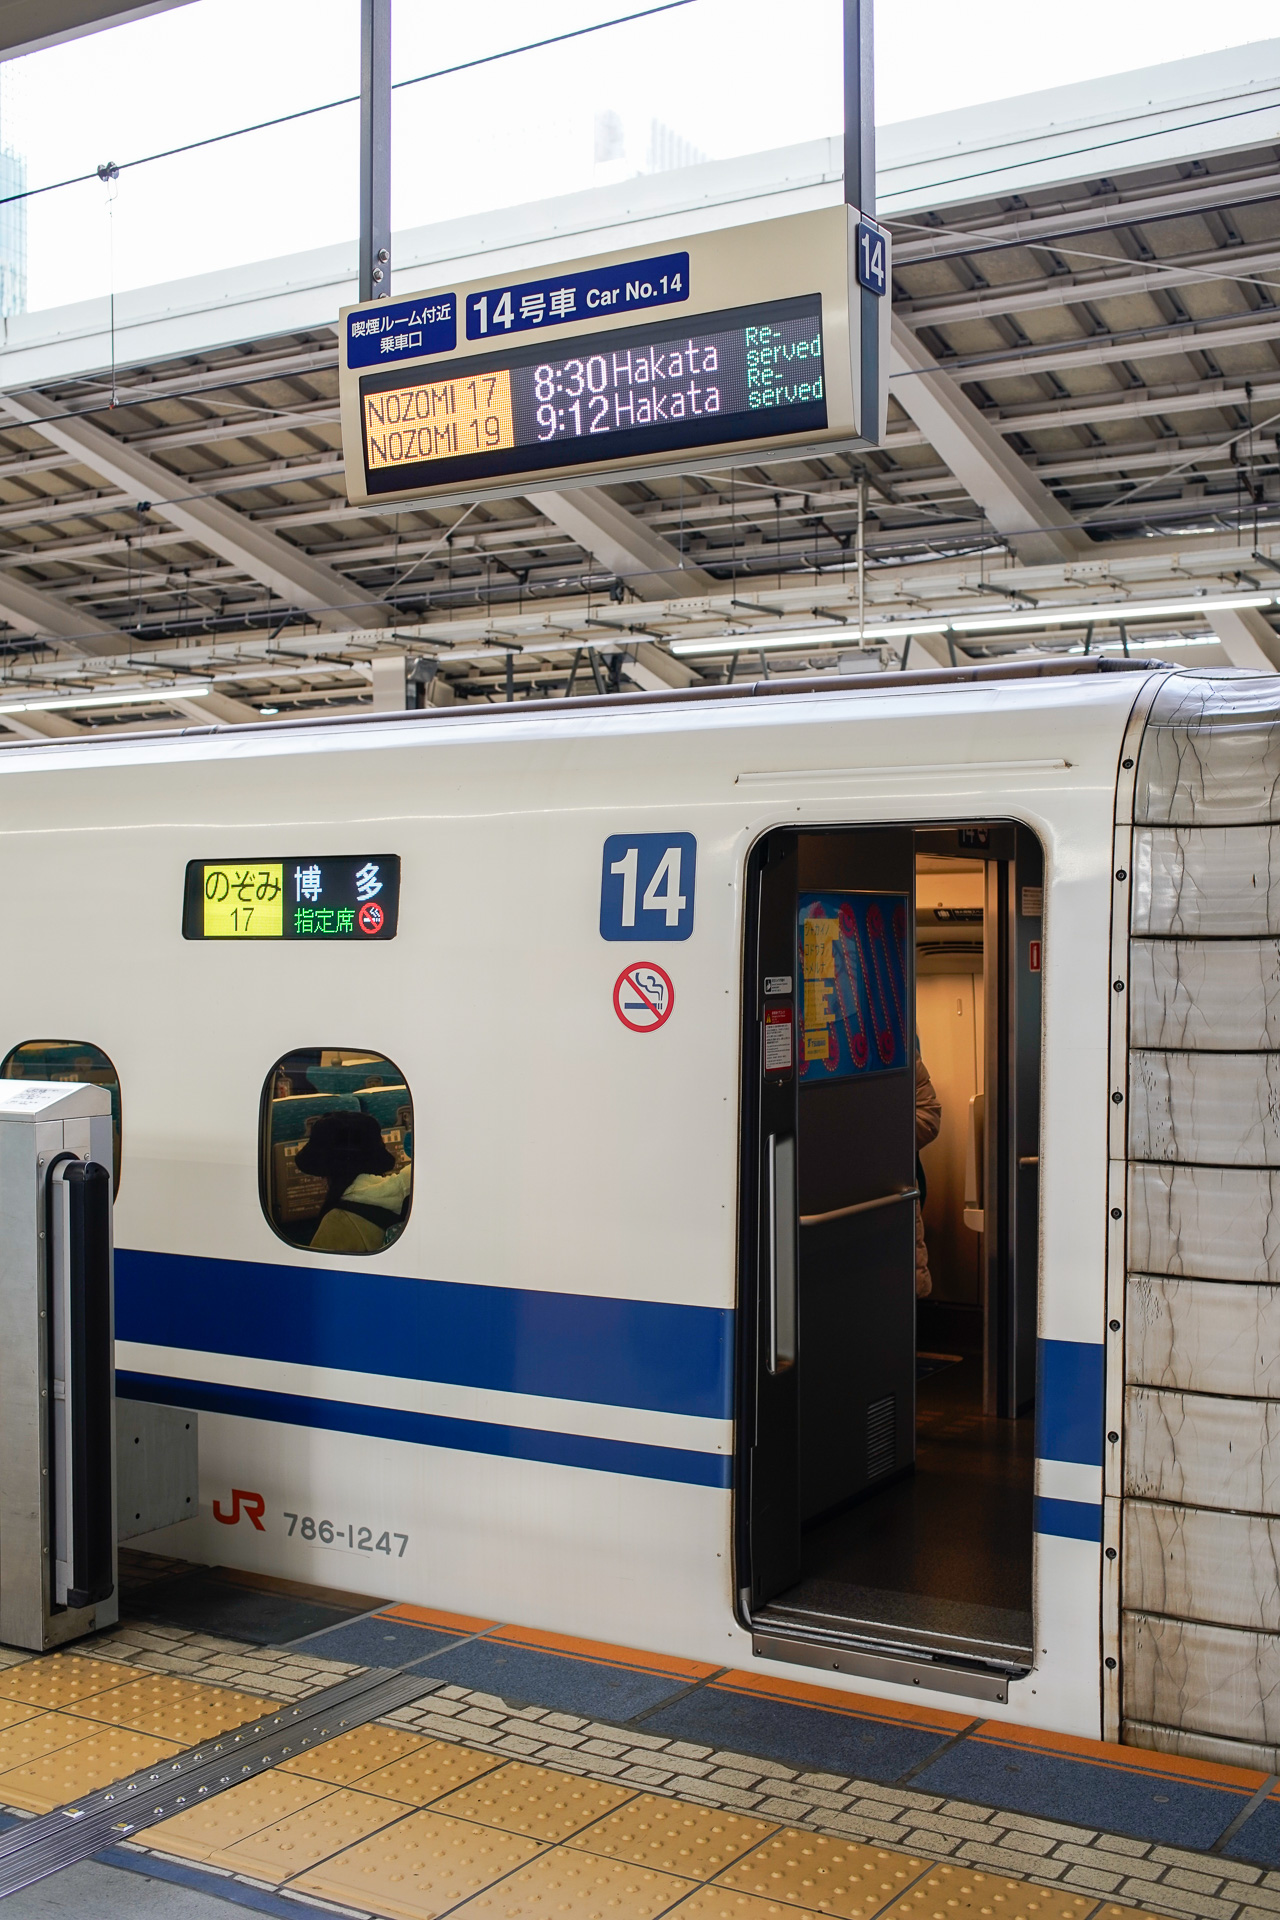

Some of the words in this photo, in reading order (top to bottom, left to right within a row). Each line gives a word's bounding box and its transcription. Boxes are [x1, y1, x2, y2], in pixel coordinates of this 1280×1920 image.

[861, 232, 885, 288] 14
[586, 288, 619, 309] Car
[626, 273, 682, 301] No.14
[351, 304, 451, 338] 喫煙ルーム付近
[746, 326, 781, 346] Re-
[380, 331, 422, 354] 乗車口
[747, 334, 821, 367] served
[368, 384, 455, 427] NOZOMI
[468, 377, 497, 410] 17
[534, 356, 608, 402] 8:30
[613, 340, 718, 387] Hakata
[747, 368, 782, 388] Re-
[749, 376, 823, 408] served
[370, 422, 458, 464] NOZOMI
[470, 416, 500, 448] 19
[537, 395, 610, 441] 9:12
[615, 381, 720, 427] Hakata
[205, 870, 282, 902] のぞみ
[610, 847, 687, 927] 14
[230, 907, 255, 932] 17
[294, 907, 355, 933] 指定席
[213, 1488, 266, 1531] JR
[283, 1512, 409, 1558] 786-1247
